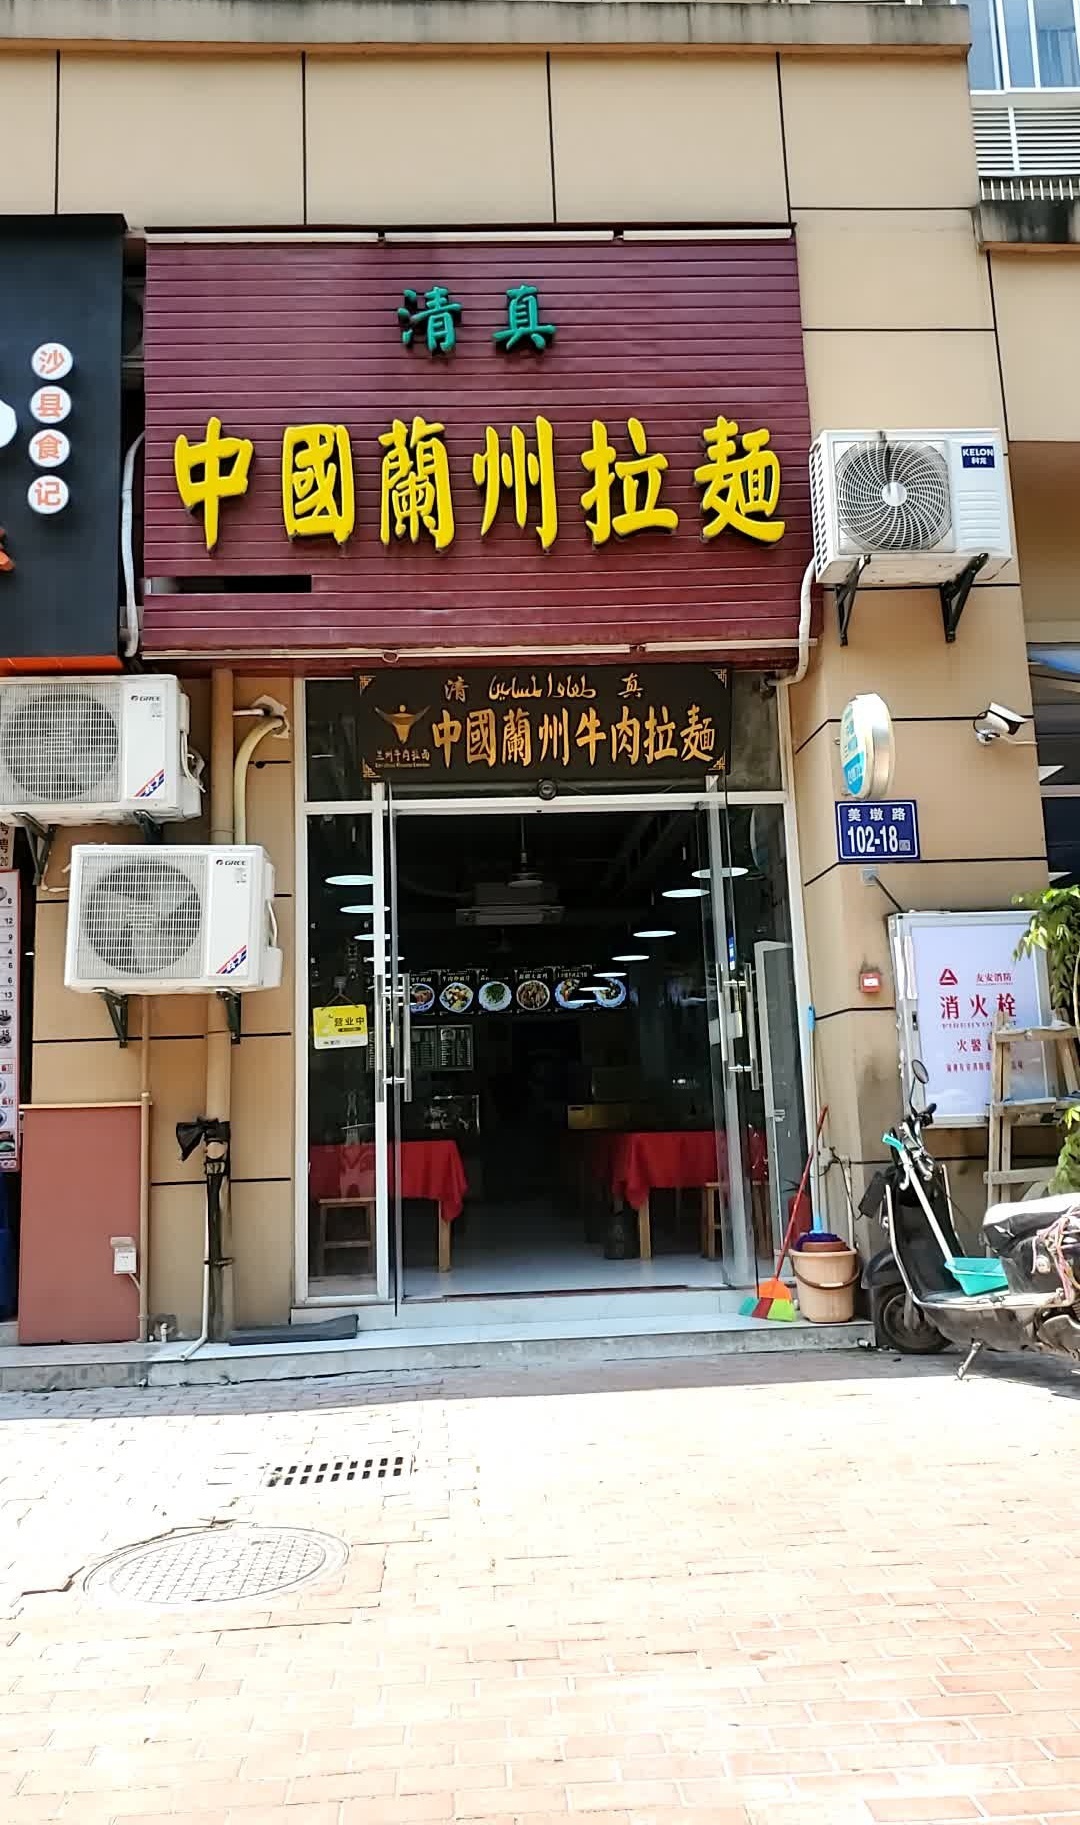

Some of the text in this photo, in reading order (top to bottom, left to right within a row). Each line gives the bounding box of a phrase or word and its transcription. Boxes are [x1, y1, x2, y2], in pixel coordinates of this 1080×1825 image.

[397, 285, 556, 352] 清真
[35, 350, 65, 507] 沙县食记
[962, 448, 993, 456] KELON
[847, 807, 906, 822] 美墩路
[847, 825, 899, 853] 102-18
[940, 992, 1017, 1020] 消火栓
[334, 1016, 365, 1027] 营业中
